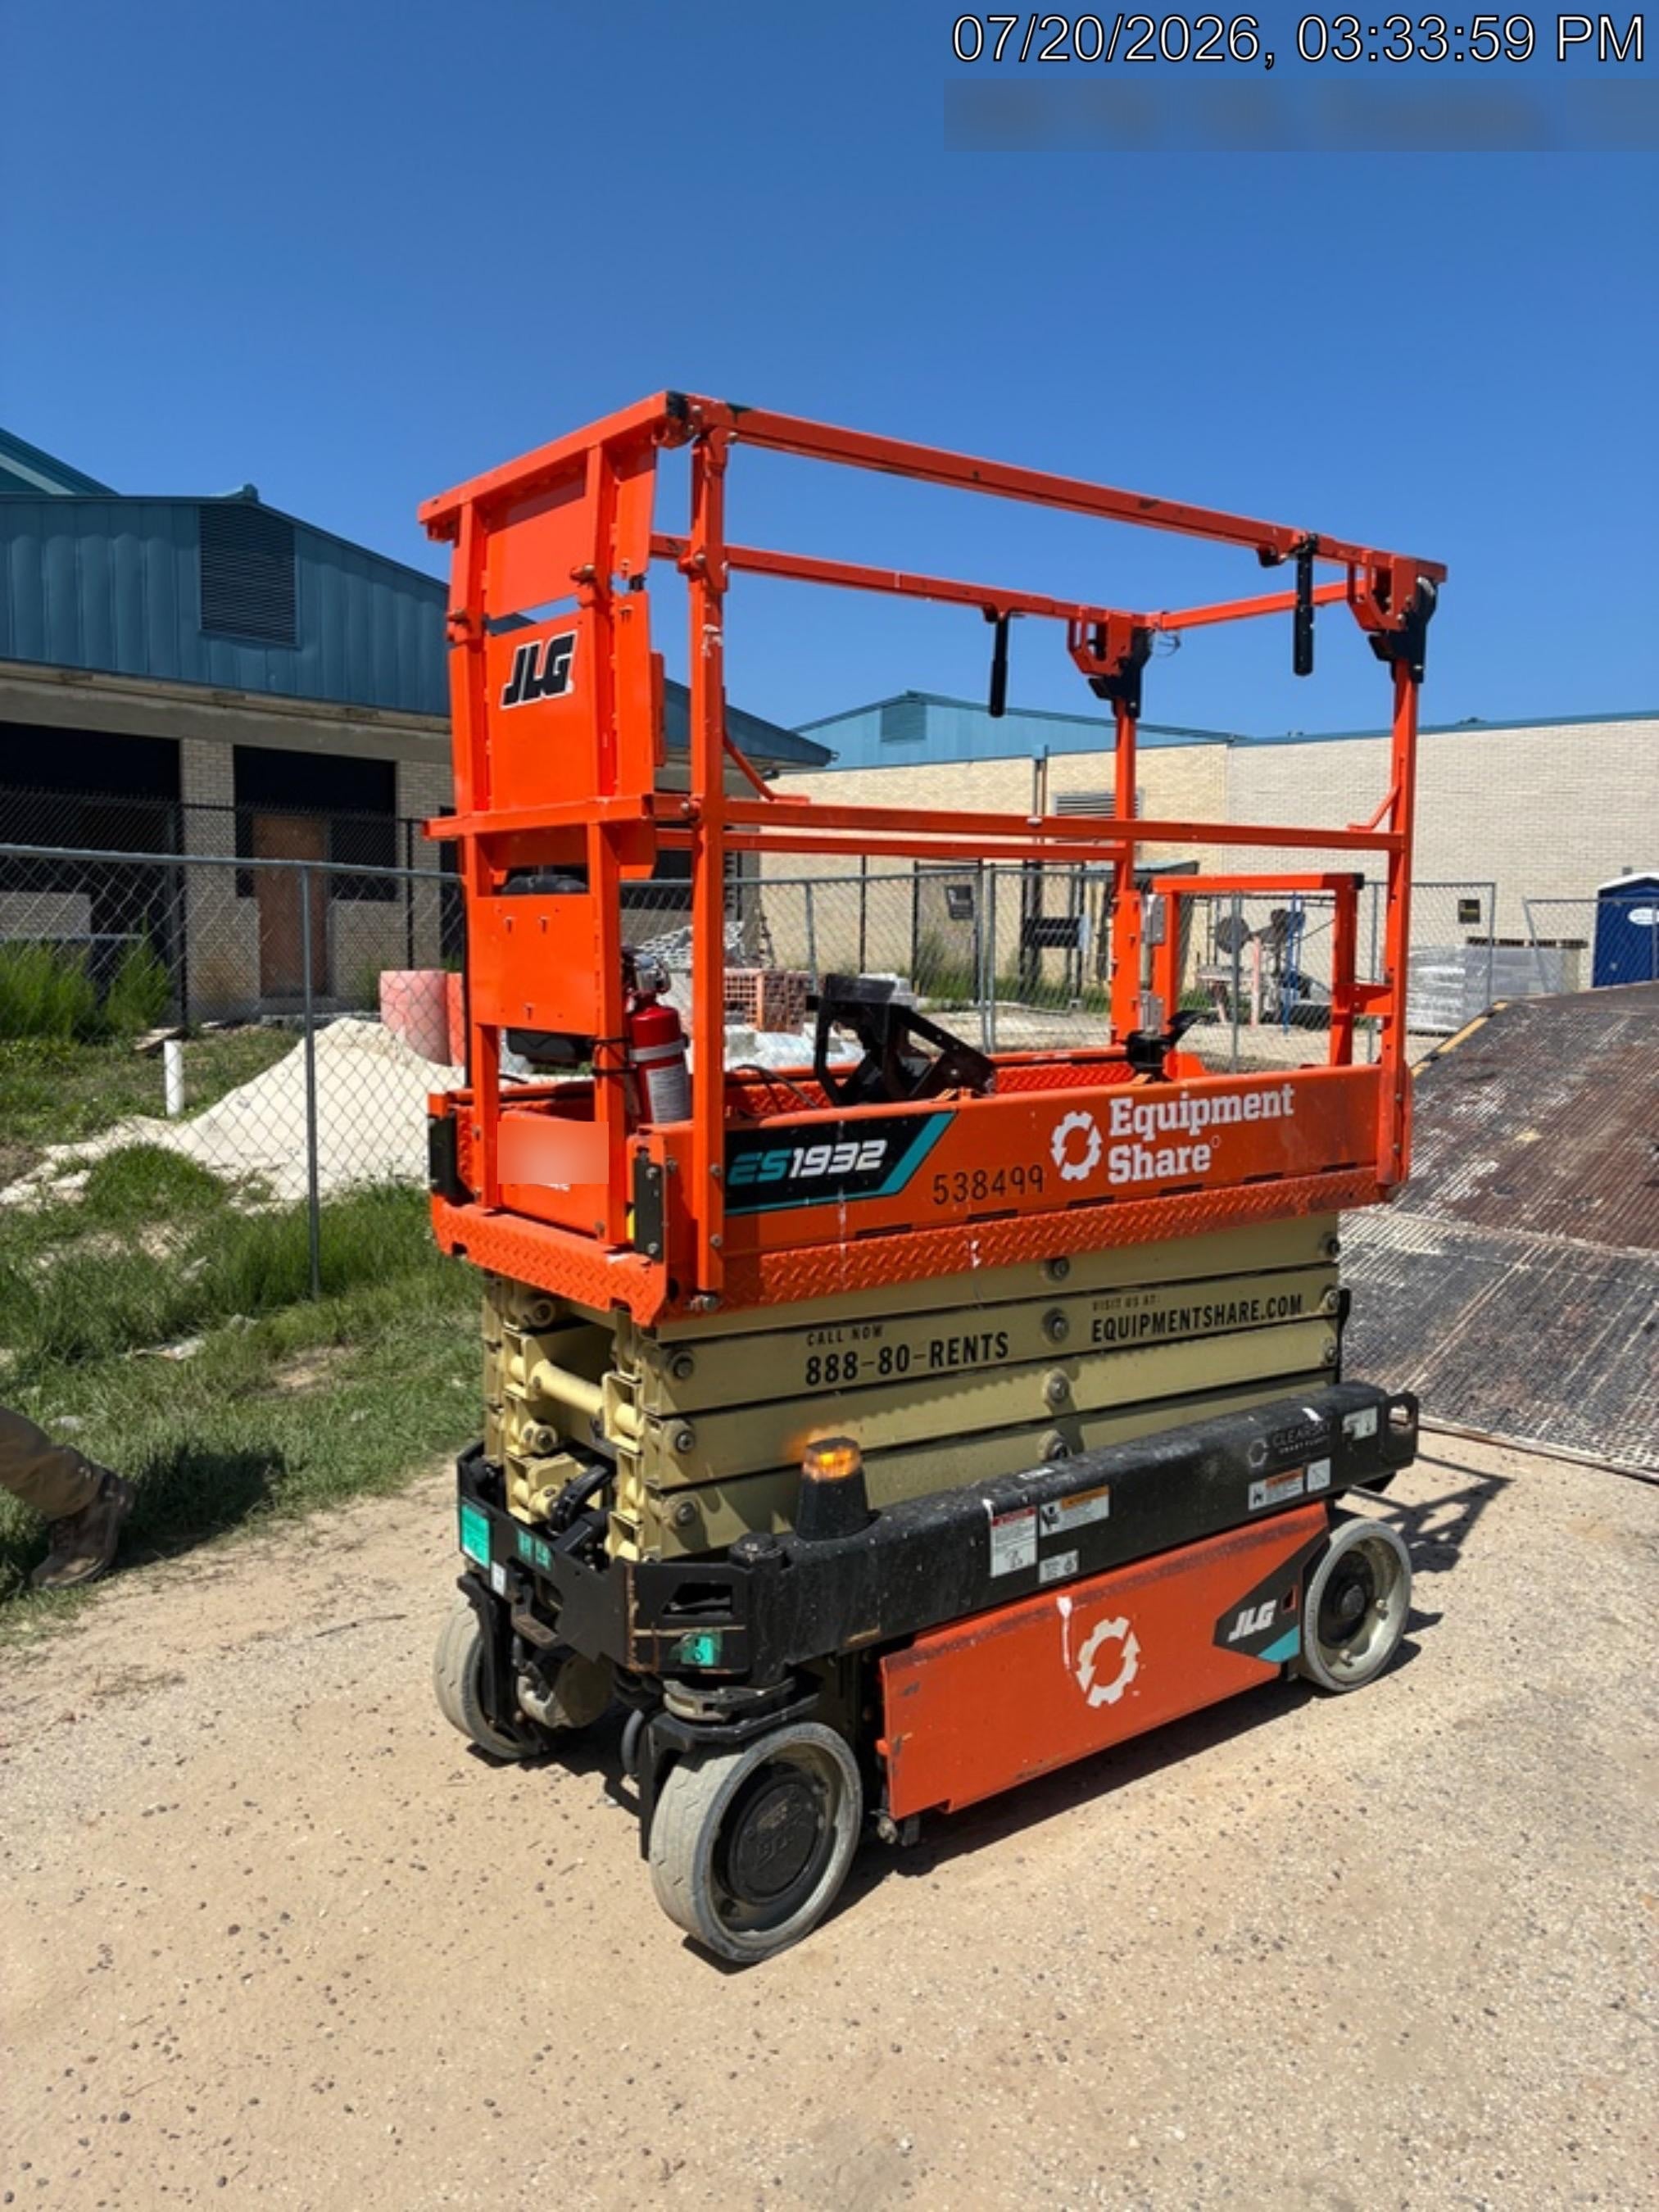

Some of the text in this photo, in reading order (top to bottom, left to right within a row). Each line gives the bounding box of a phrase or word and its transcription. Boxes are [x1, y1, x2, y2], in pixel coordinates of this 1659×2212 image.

[501, 631, 578, 709] JLG
[1109, 1083, 1295, 1140] Equipment
[727, 1140, 888, 1185] ES1932
[932, 1164, 1045, 1205] 538499
[1108, 1143, 1212, 1185] Share
[805, 1324, 884, 1347] CALL NOW
[1091, 1293, 1303, 1343] EQUIPMENTSHARE.COM
[805, 1330, 1009, 1386] 888-80-RENTS
[1227, 1599, 1277, 1643] JLG
